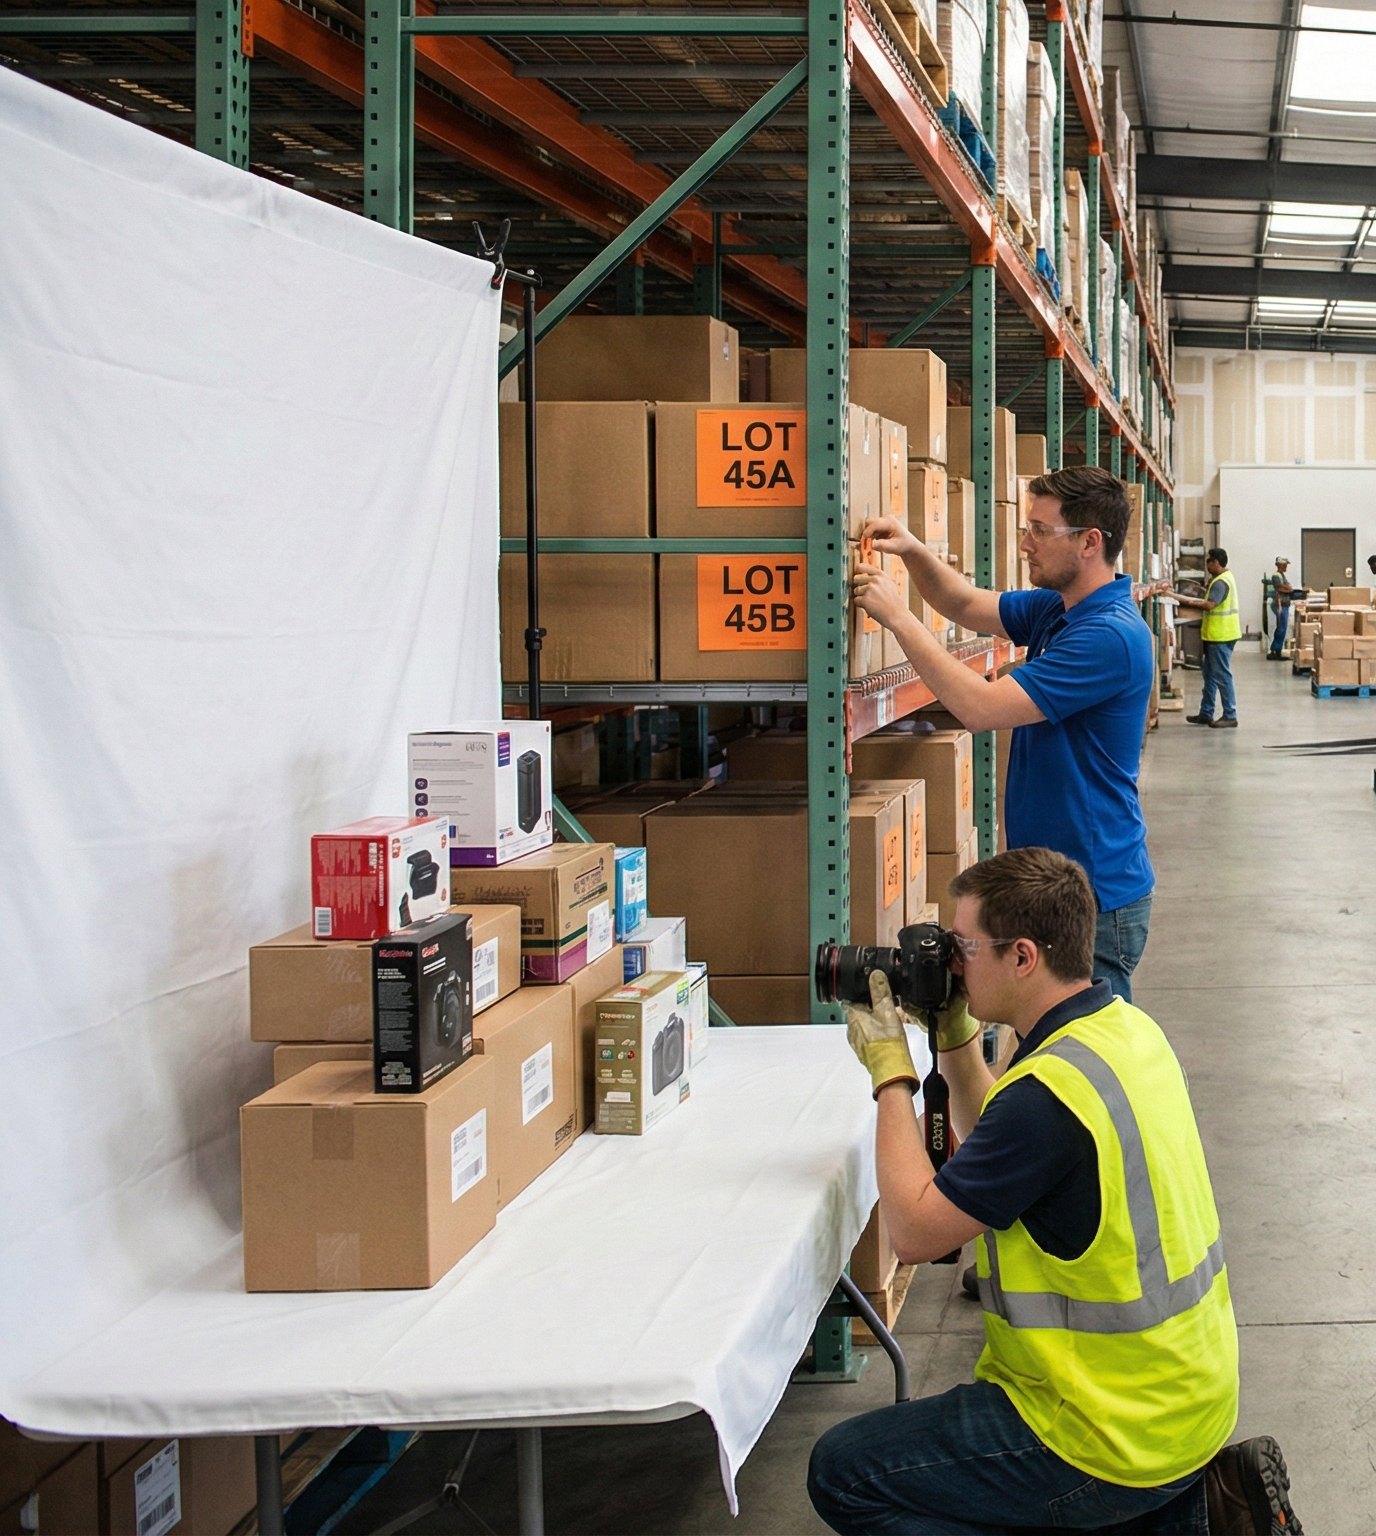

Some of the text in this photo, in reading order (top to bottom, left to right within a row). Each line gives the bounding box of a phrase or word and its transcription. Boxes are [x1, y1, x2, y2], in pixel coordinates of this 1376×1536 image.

[721, 422, 797, 451] LOT
[723, 460, 796, 489] 45A
[723, 565, 799, 595] LOT
[724, 603, 796, 633] 45B
